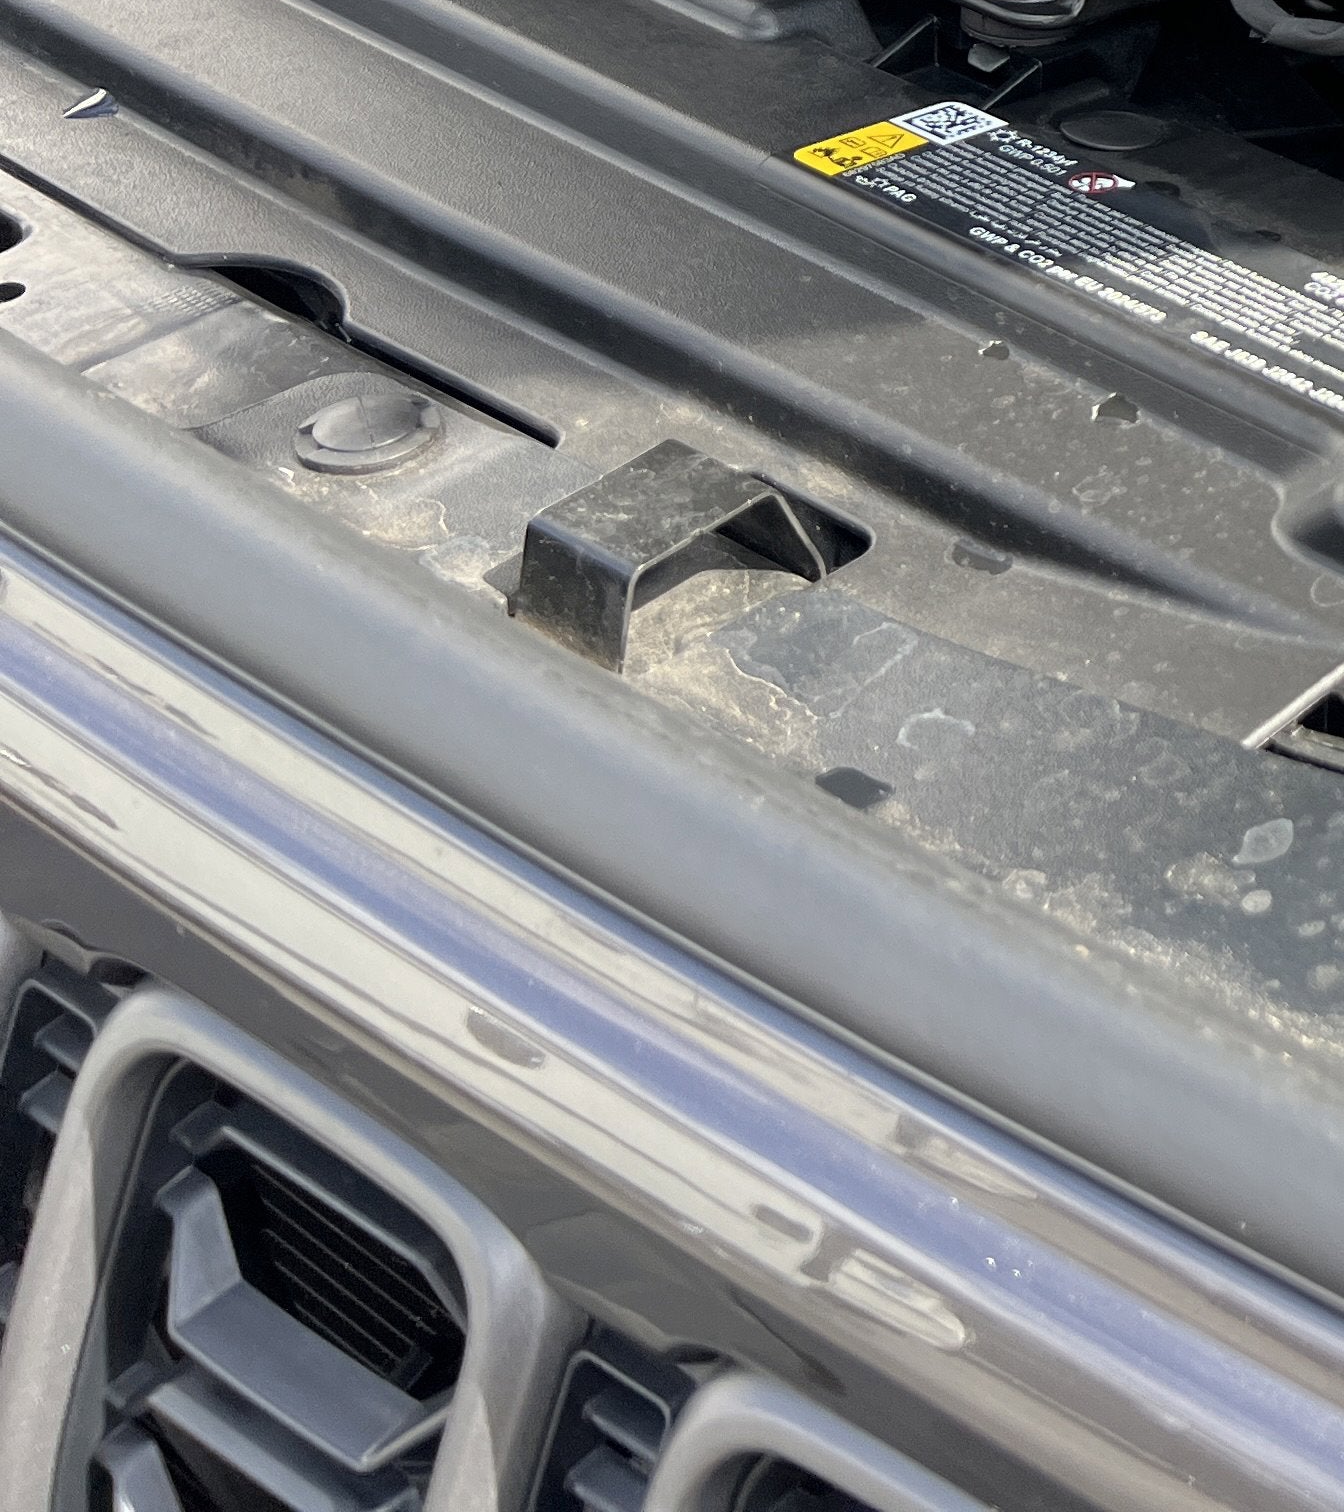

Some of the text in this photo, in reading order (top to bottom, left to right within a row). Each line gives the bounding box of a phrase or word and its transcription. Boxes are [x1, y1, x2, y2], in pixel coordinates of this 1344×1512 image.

[999, 145, 1068, 176] GWP 0.501
[1017, 138, 1078, 167] R-1234yf
[883, 184, 917, 203] PAG
[969, 226, 1008, 247] GWP
[1004, 242, 1020, 254] &
[1018, 249, 1055, 268] CO2
[1046, 264, 1079, 281] per
[1075, 276, 1104, 292] EU
[1303, 281, 1339, 301] CO2
[1190, 330, 1231, 353] SAE
